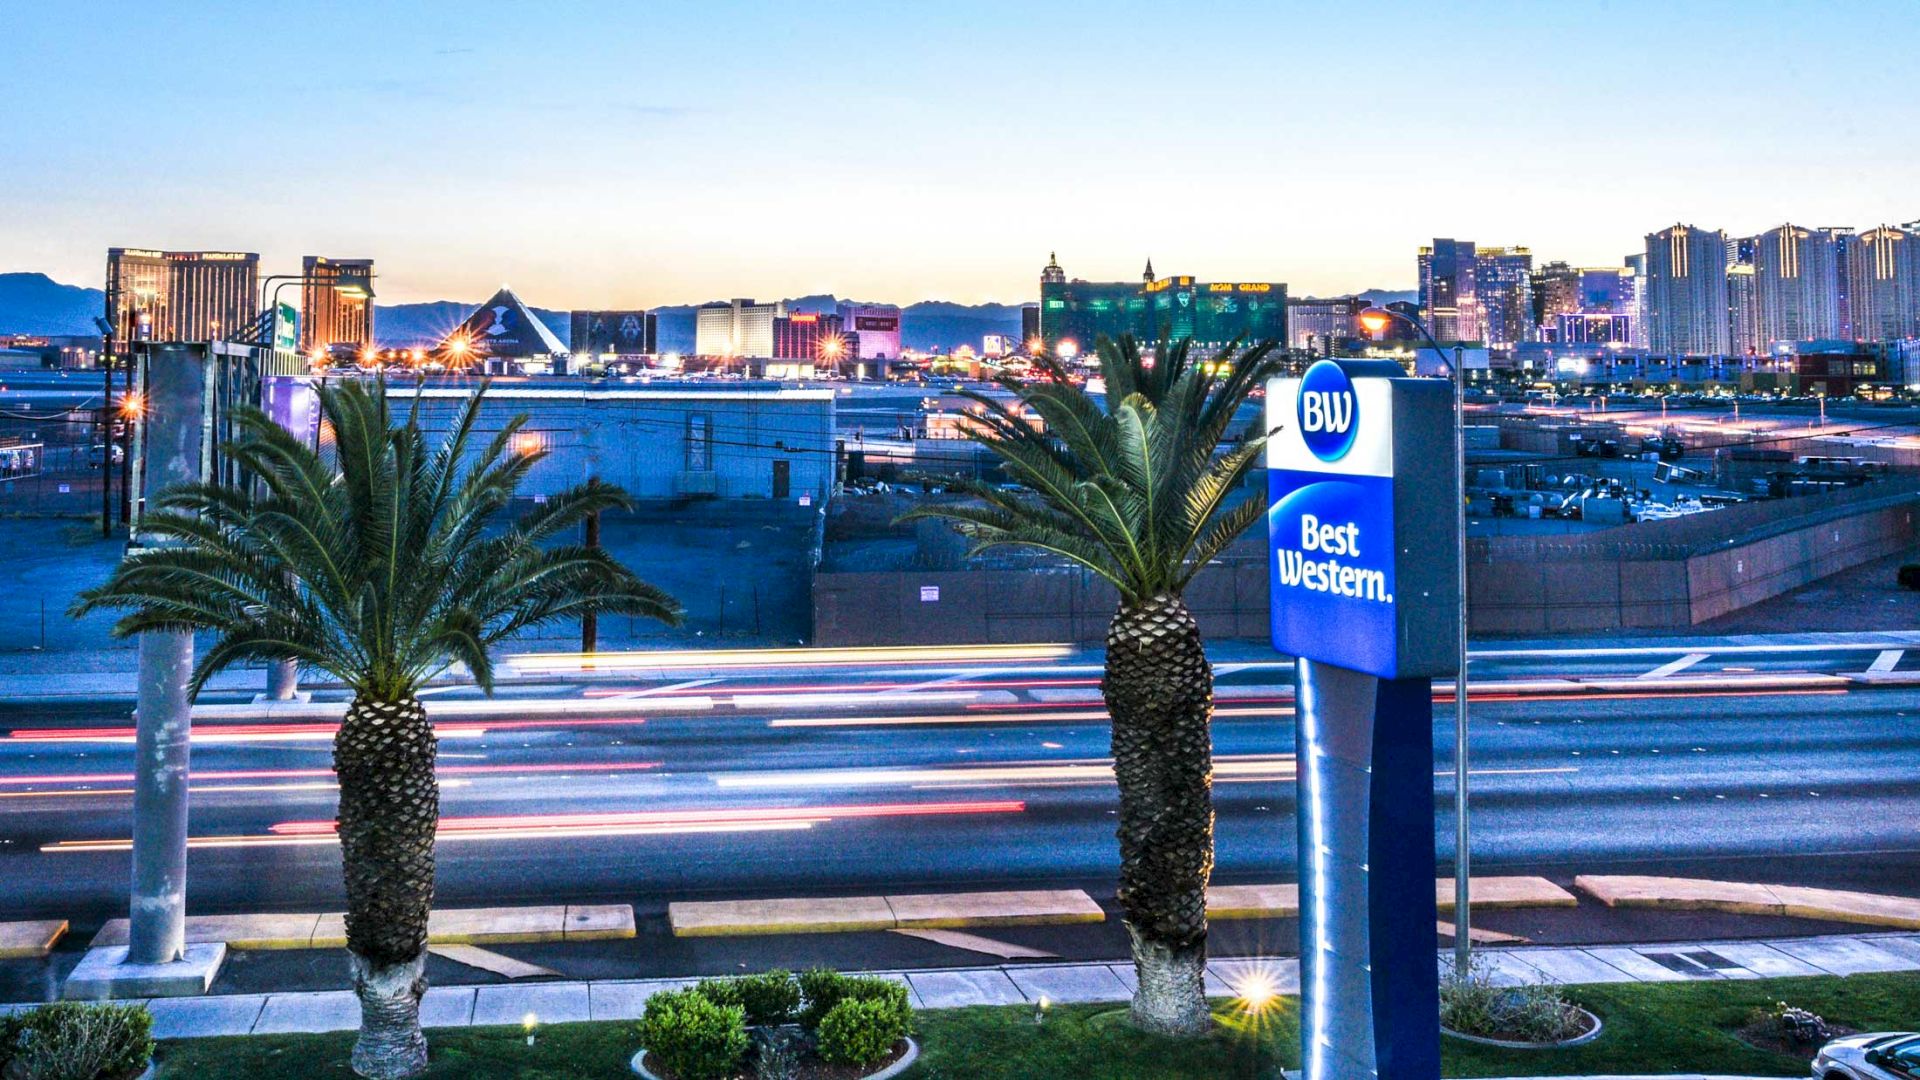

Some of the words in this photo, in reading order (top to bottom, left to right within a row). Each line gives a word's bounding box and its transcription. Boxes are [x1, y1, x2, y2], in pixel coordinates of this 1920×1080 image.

[1210, 283, 1233, 292] MGM
[1238, 283, 1271, 292] GRAND
[1303, 390, 1352, 434] BW
[1301, 513, 1360, 558] Best
[1277, 548, 1393, 604] Western.
